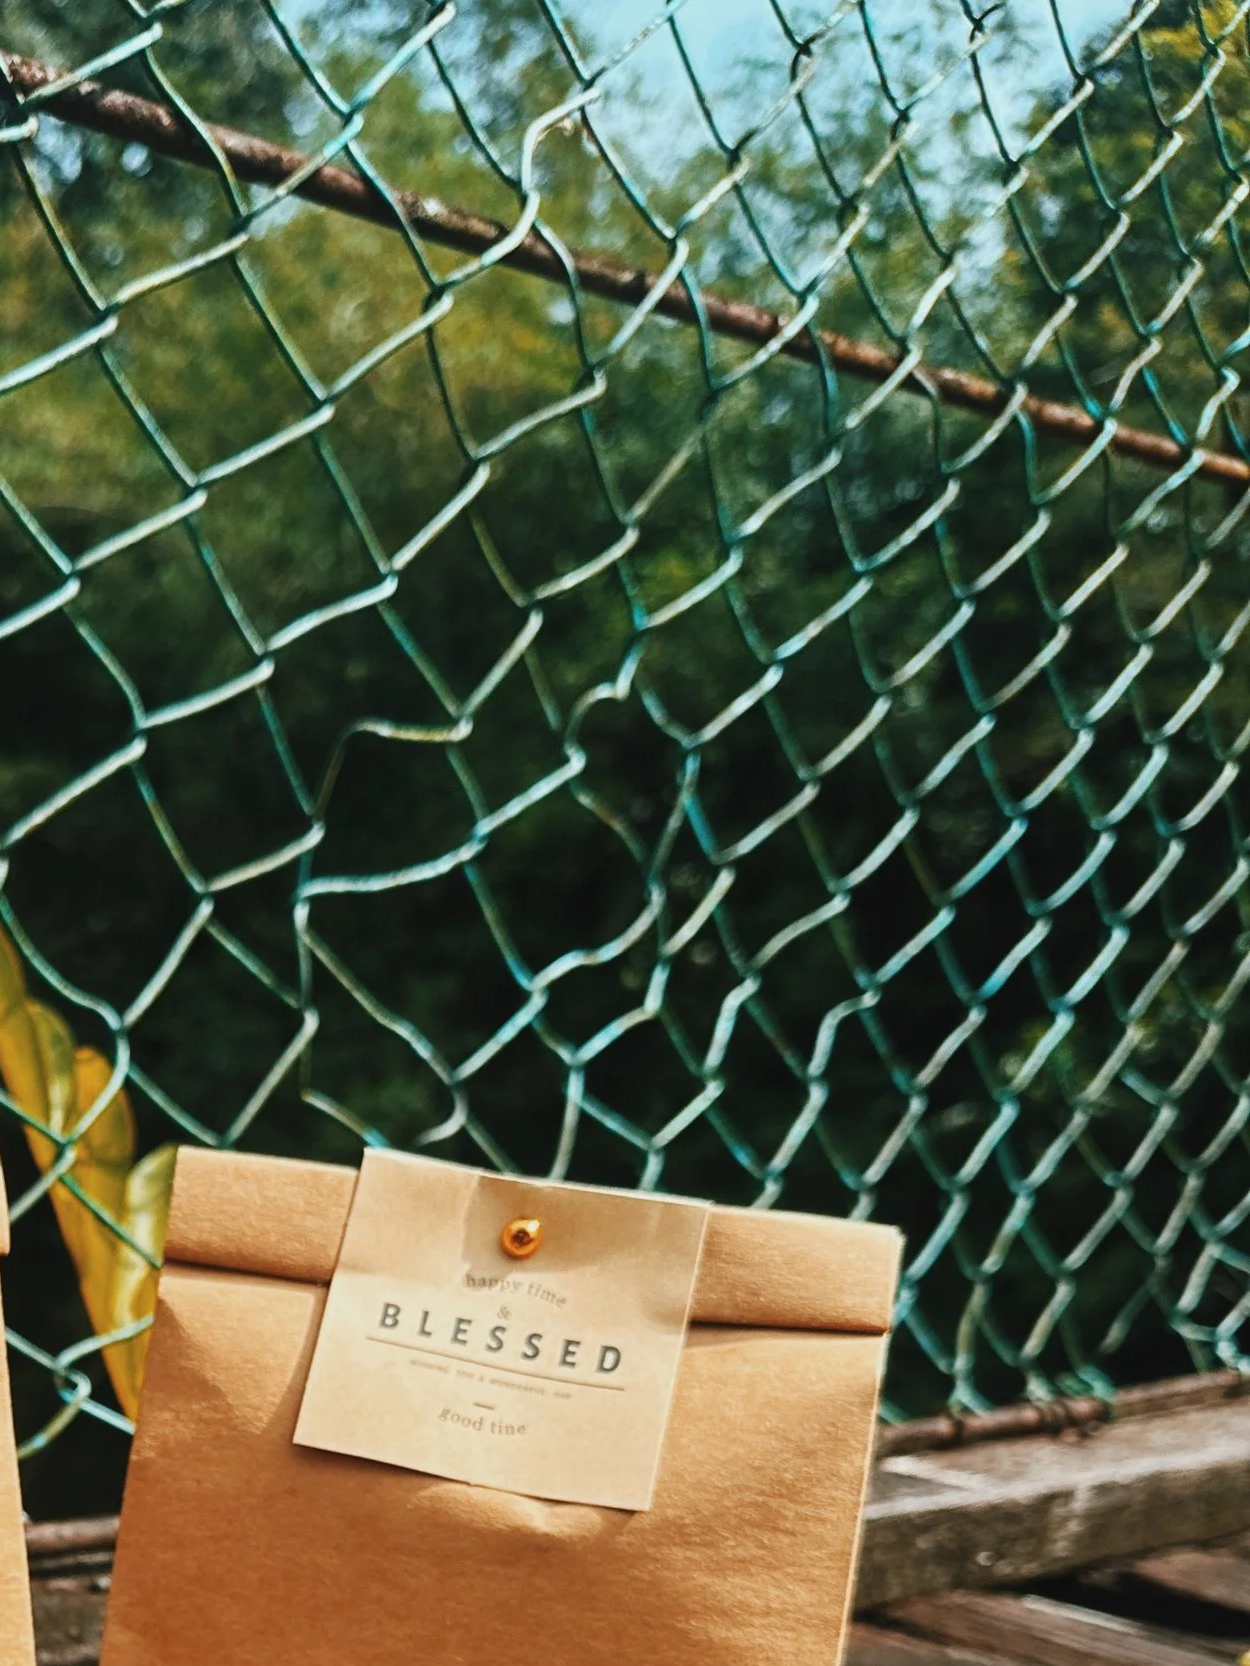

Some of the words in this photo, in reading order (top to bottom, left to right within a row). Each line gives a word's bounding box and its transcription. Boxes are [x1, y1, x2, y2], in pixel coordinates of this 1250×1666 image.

[465, 1273, 523, 1294] happy
[527, 1281, 567, 1309] time
[378, 1302, 623, 1376] BLESSED
[438, 1407, 484, 1432] good
[489, 1419, 528, 1437] tine
